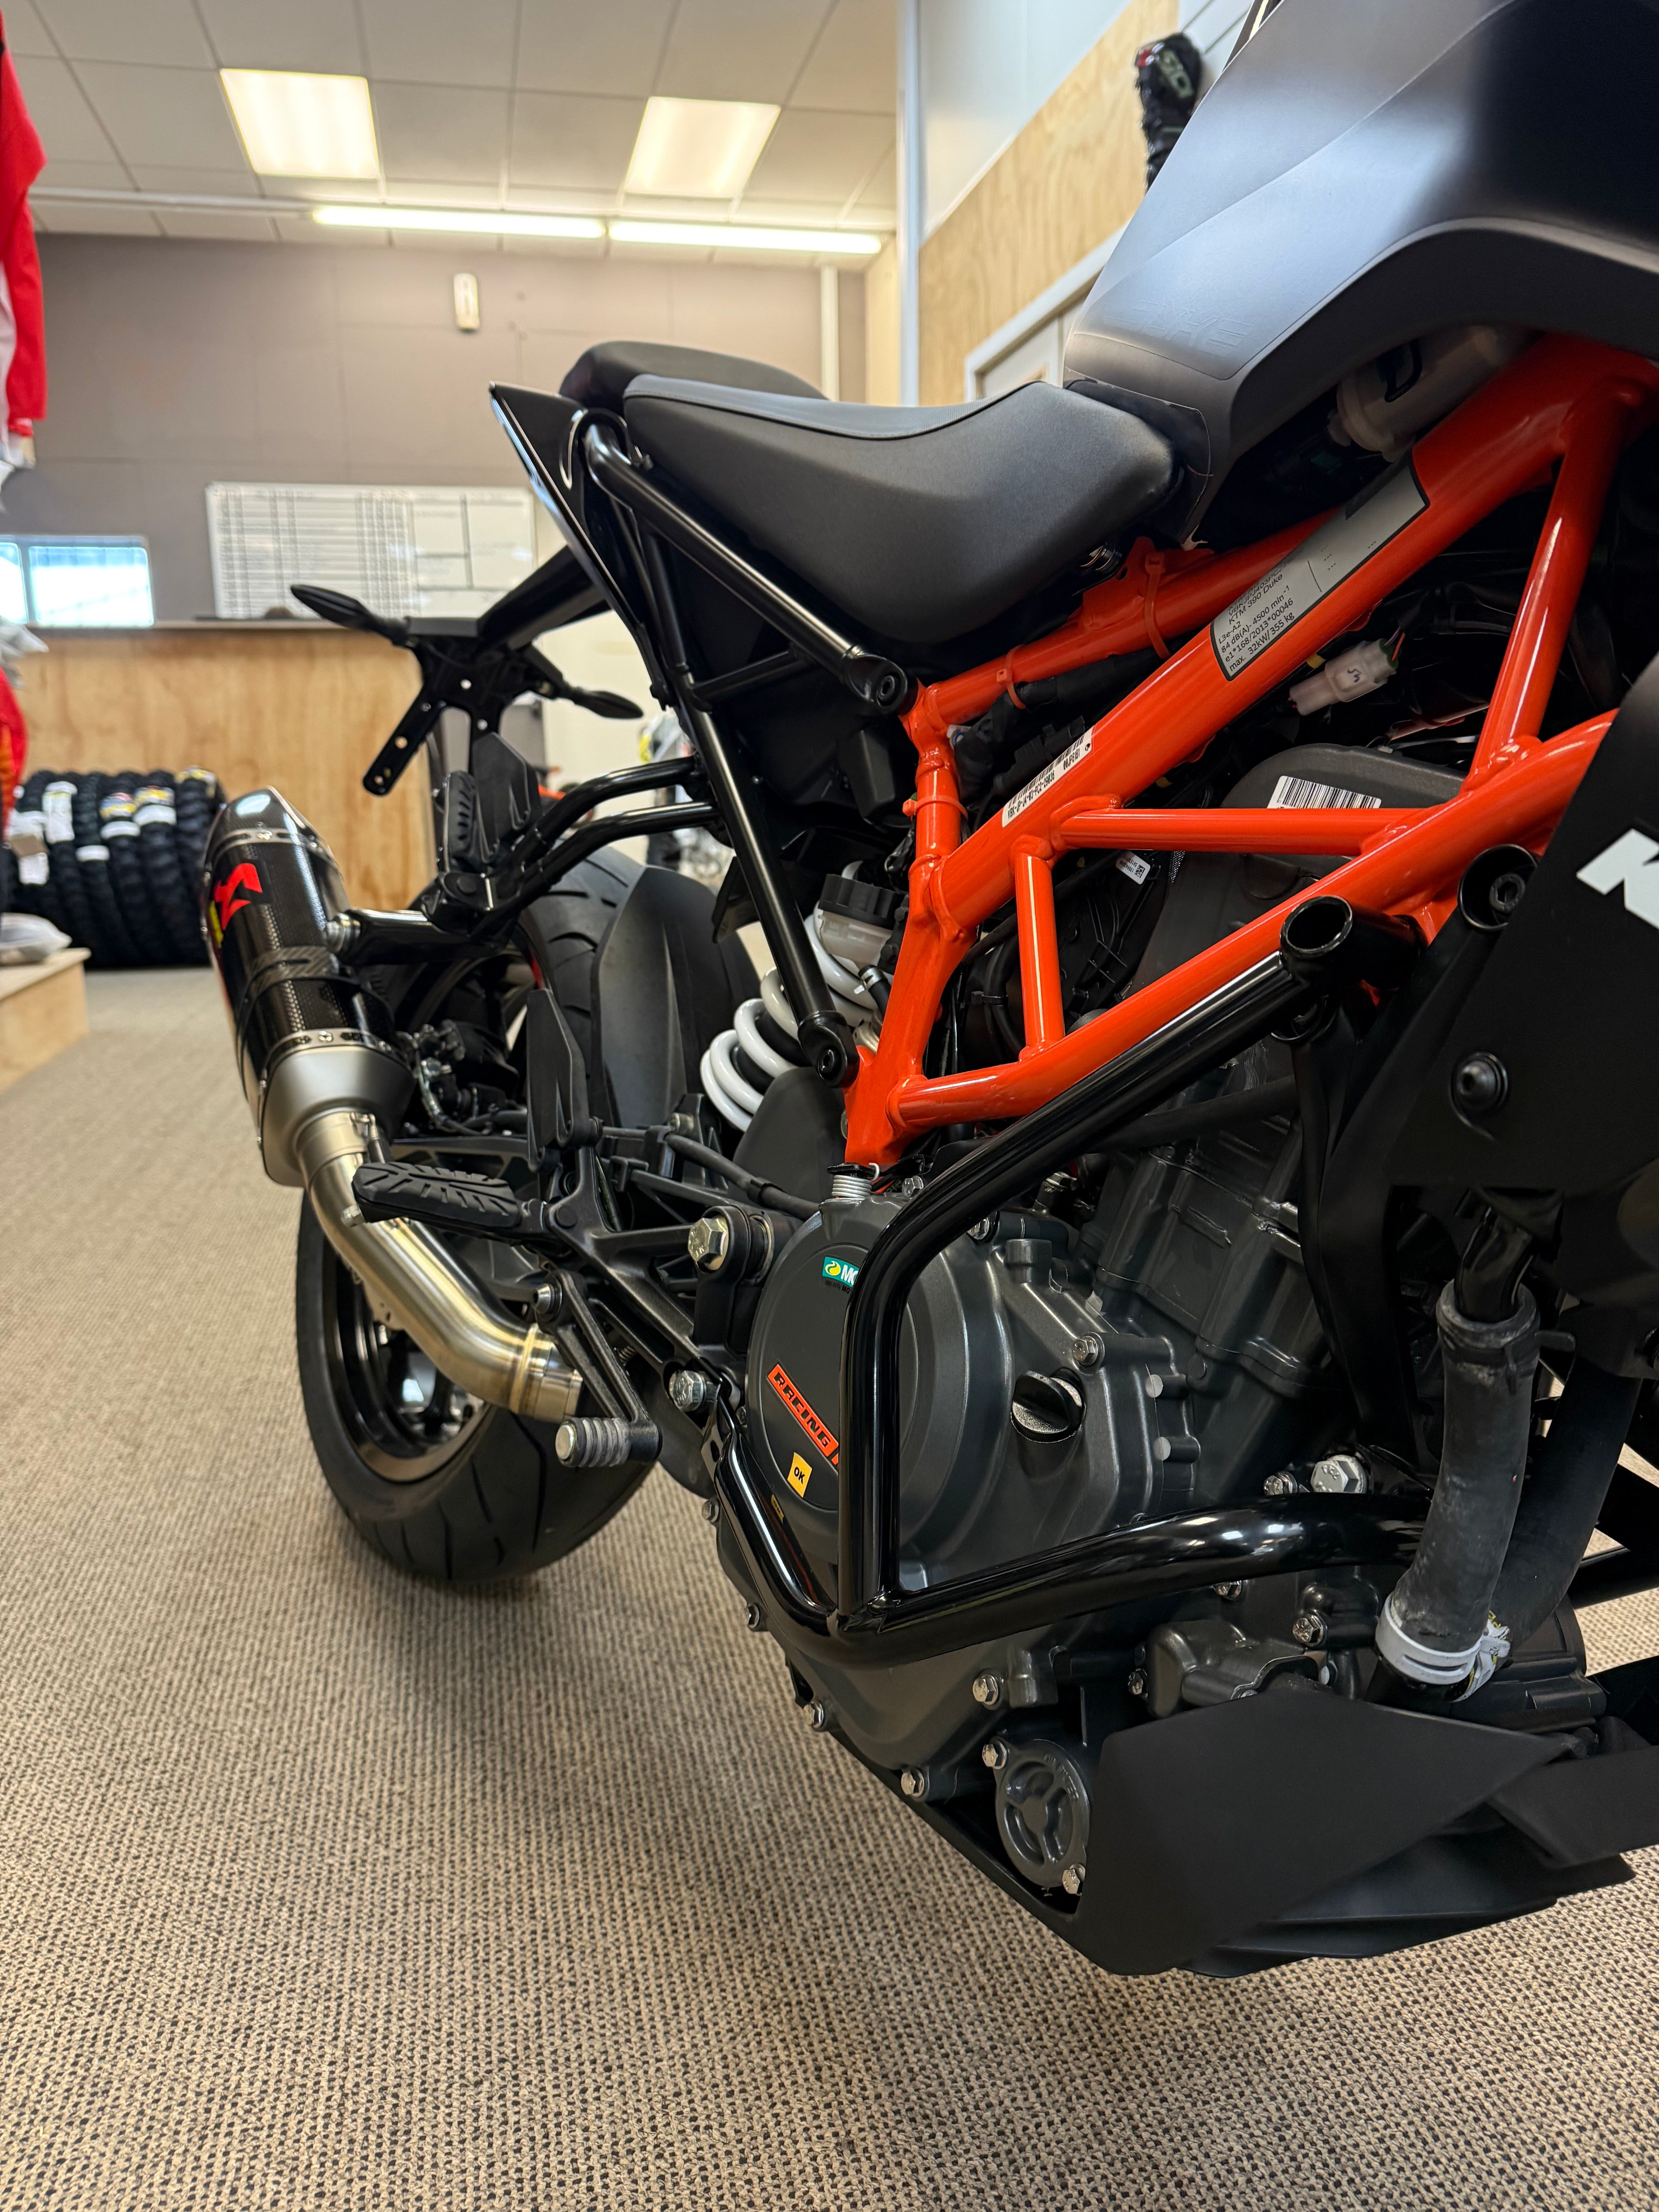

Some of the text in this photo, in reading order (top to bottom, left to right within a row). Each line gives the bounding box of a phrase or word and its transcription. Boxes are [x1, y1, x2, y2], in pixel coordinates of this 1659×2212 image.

[1229, 606, 1246, 625] KTM
[1248, 592, 1261, 608] 390
[1264, 574, 1283, 594] Duke
[1219, 621, 1241, 644] L3e-A2
[1221, 643, 1230, 653] 84
[1253, 607, 1270, 625] 4500
[1230, 656, 1246, 672] max.
[1271, 620, 1284, 635] 355
[1284, 612, 1295, 623] kg
[774, 1372, 831, 1448] RACING
[794, 1467, 805, 1484] OK
